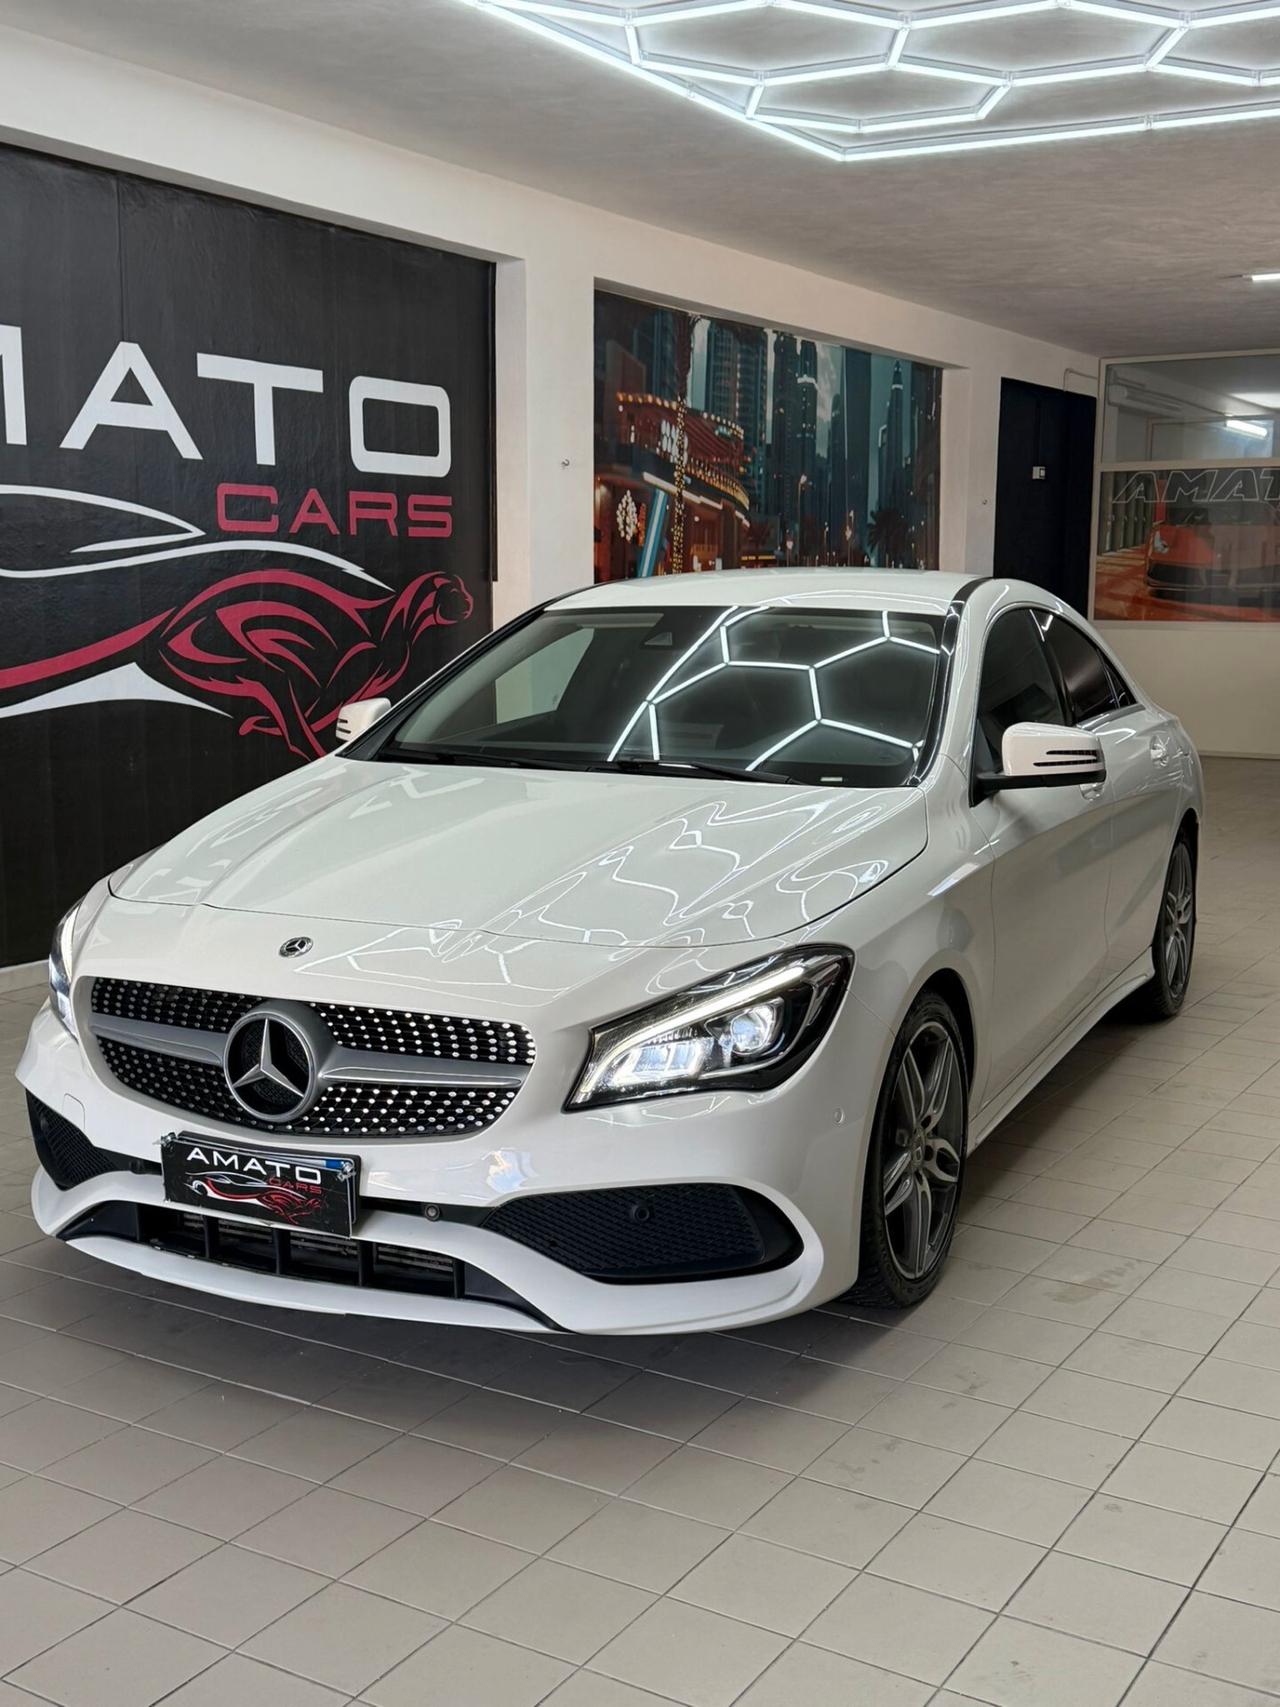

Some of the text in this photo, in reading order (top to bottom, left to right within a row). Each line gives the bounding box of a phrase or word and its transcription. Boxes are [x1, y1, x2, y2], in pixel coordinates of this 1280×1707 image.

[0, 325, 452, 478] ATO
[215, 482, 453, 538] CARS
[187, 1147, 321, 1184] AMATO
[268, 1176, 322, 1194] CARS
